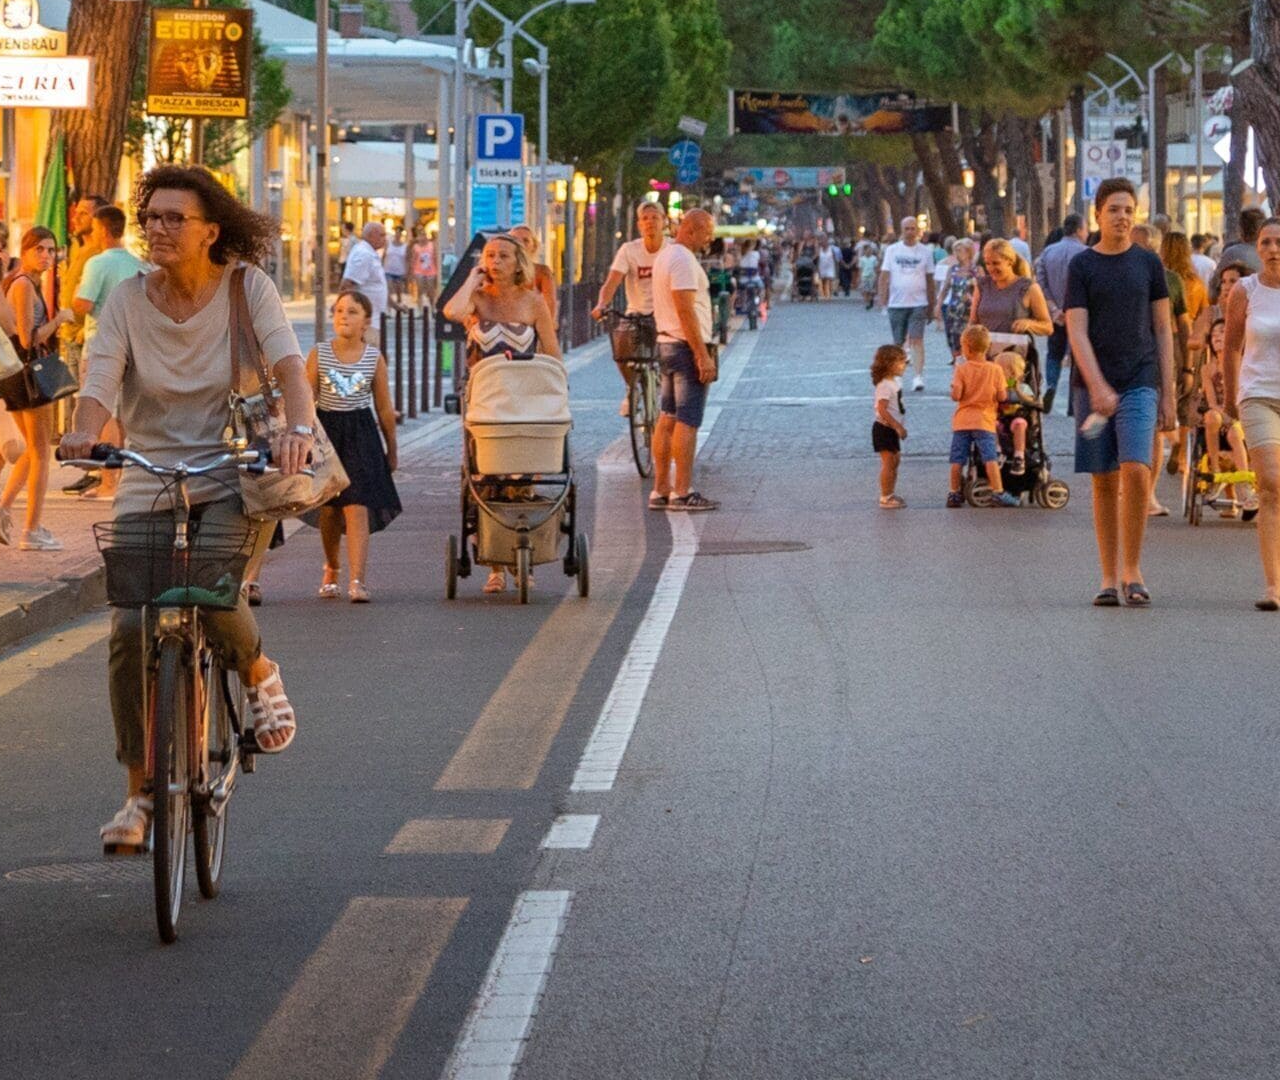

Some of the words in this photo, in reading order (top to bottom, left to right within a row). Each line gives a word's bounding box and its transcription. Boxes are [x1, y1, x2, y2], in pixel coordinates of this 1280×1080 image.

[156, 20, 242, 41] EGITTO
[153, 97, 192, 106] PIAZZA
[195, 98, 240, 108] BRESCIA
[485, 119, 515, 157] P
[480, 168, 519, 178] tickets
